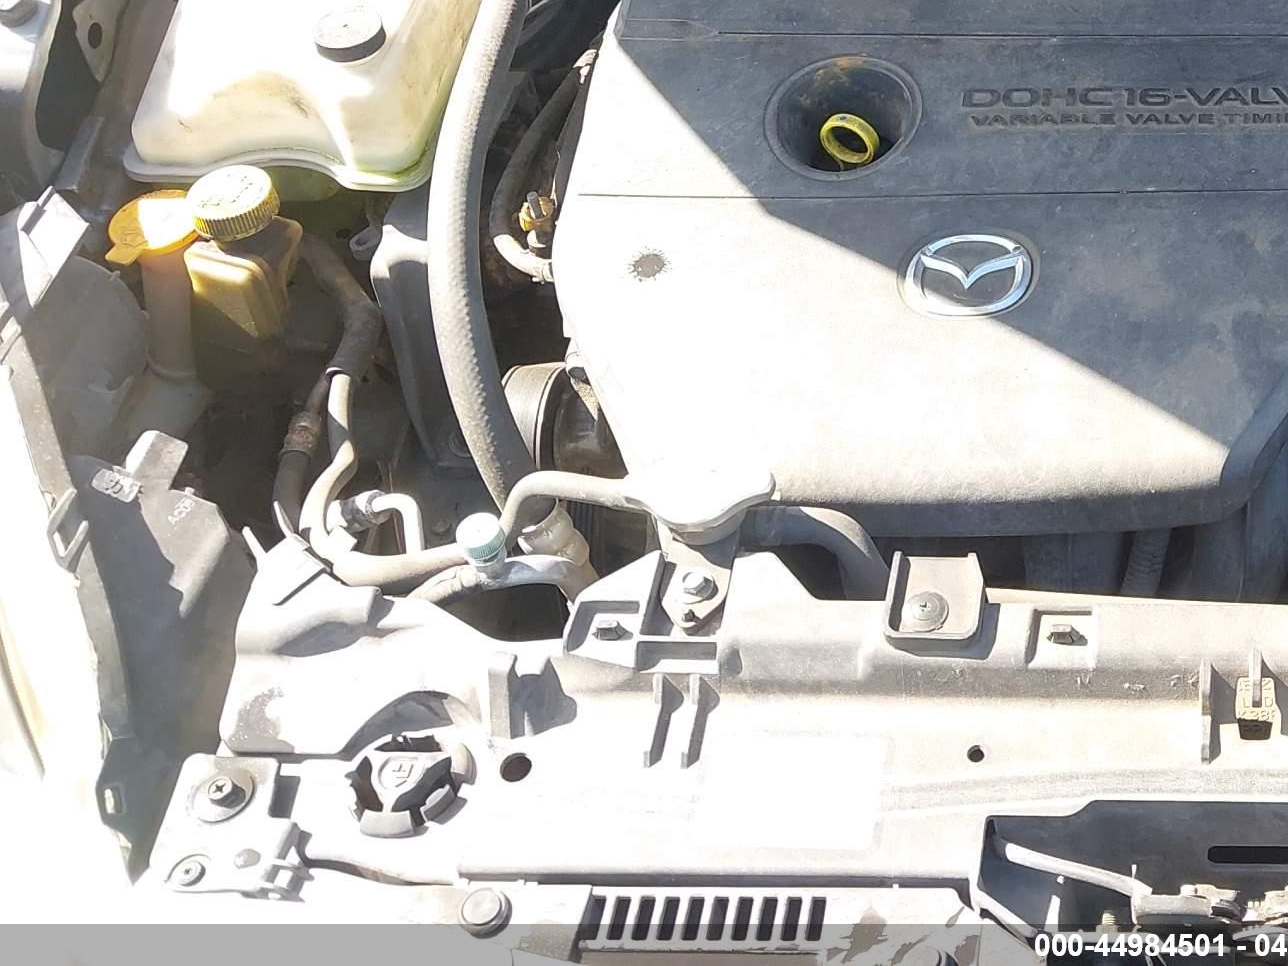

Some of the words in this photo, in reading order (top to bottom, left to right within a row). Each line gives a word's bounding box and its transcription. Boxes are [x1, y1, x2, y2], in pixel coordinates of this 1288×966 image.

[961, 87, 1113, 108] DOHC
[970, 112, 1117, 127] VARIABLE
[1125, 111, 1215, 126] VALVE
